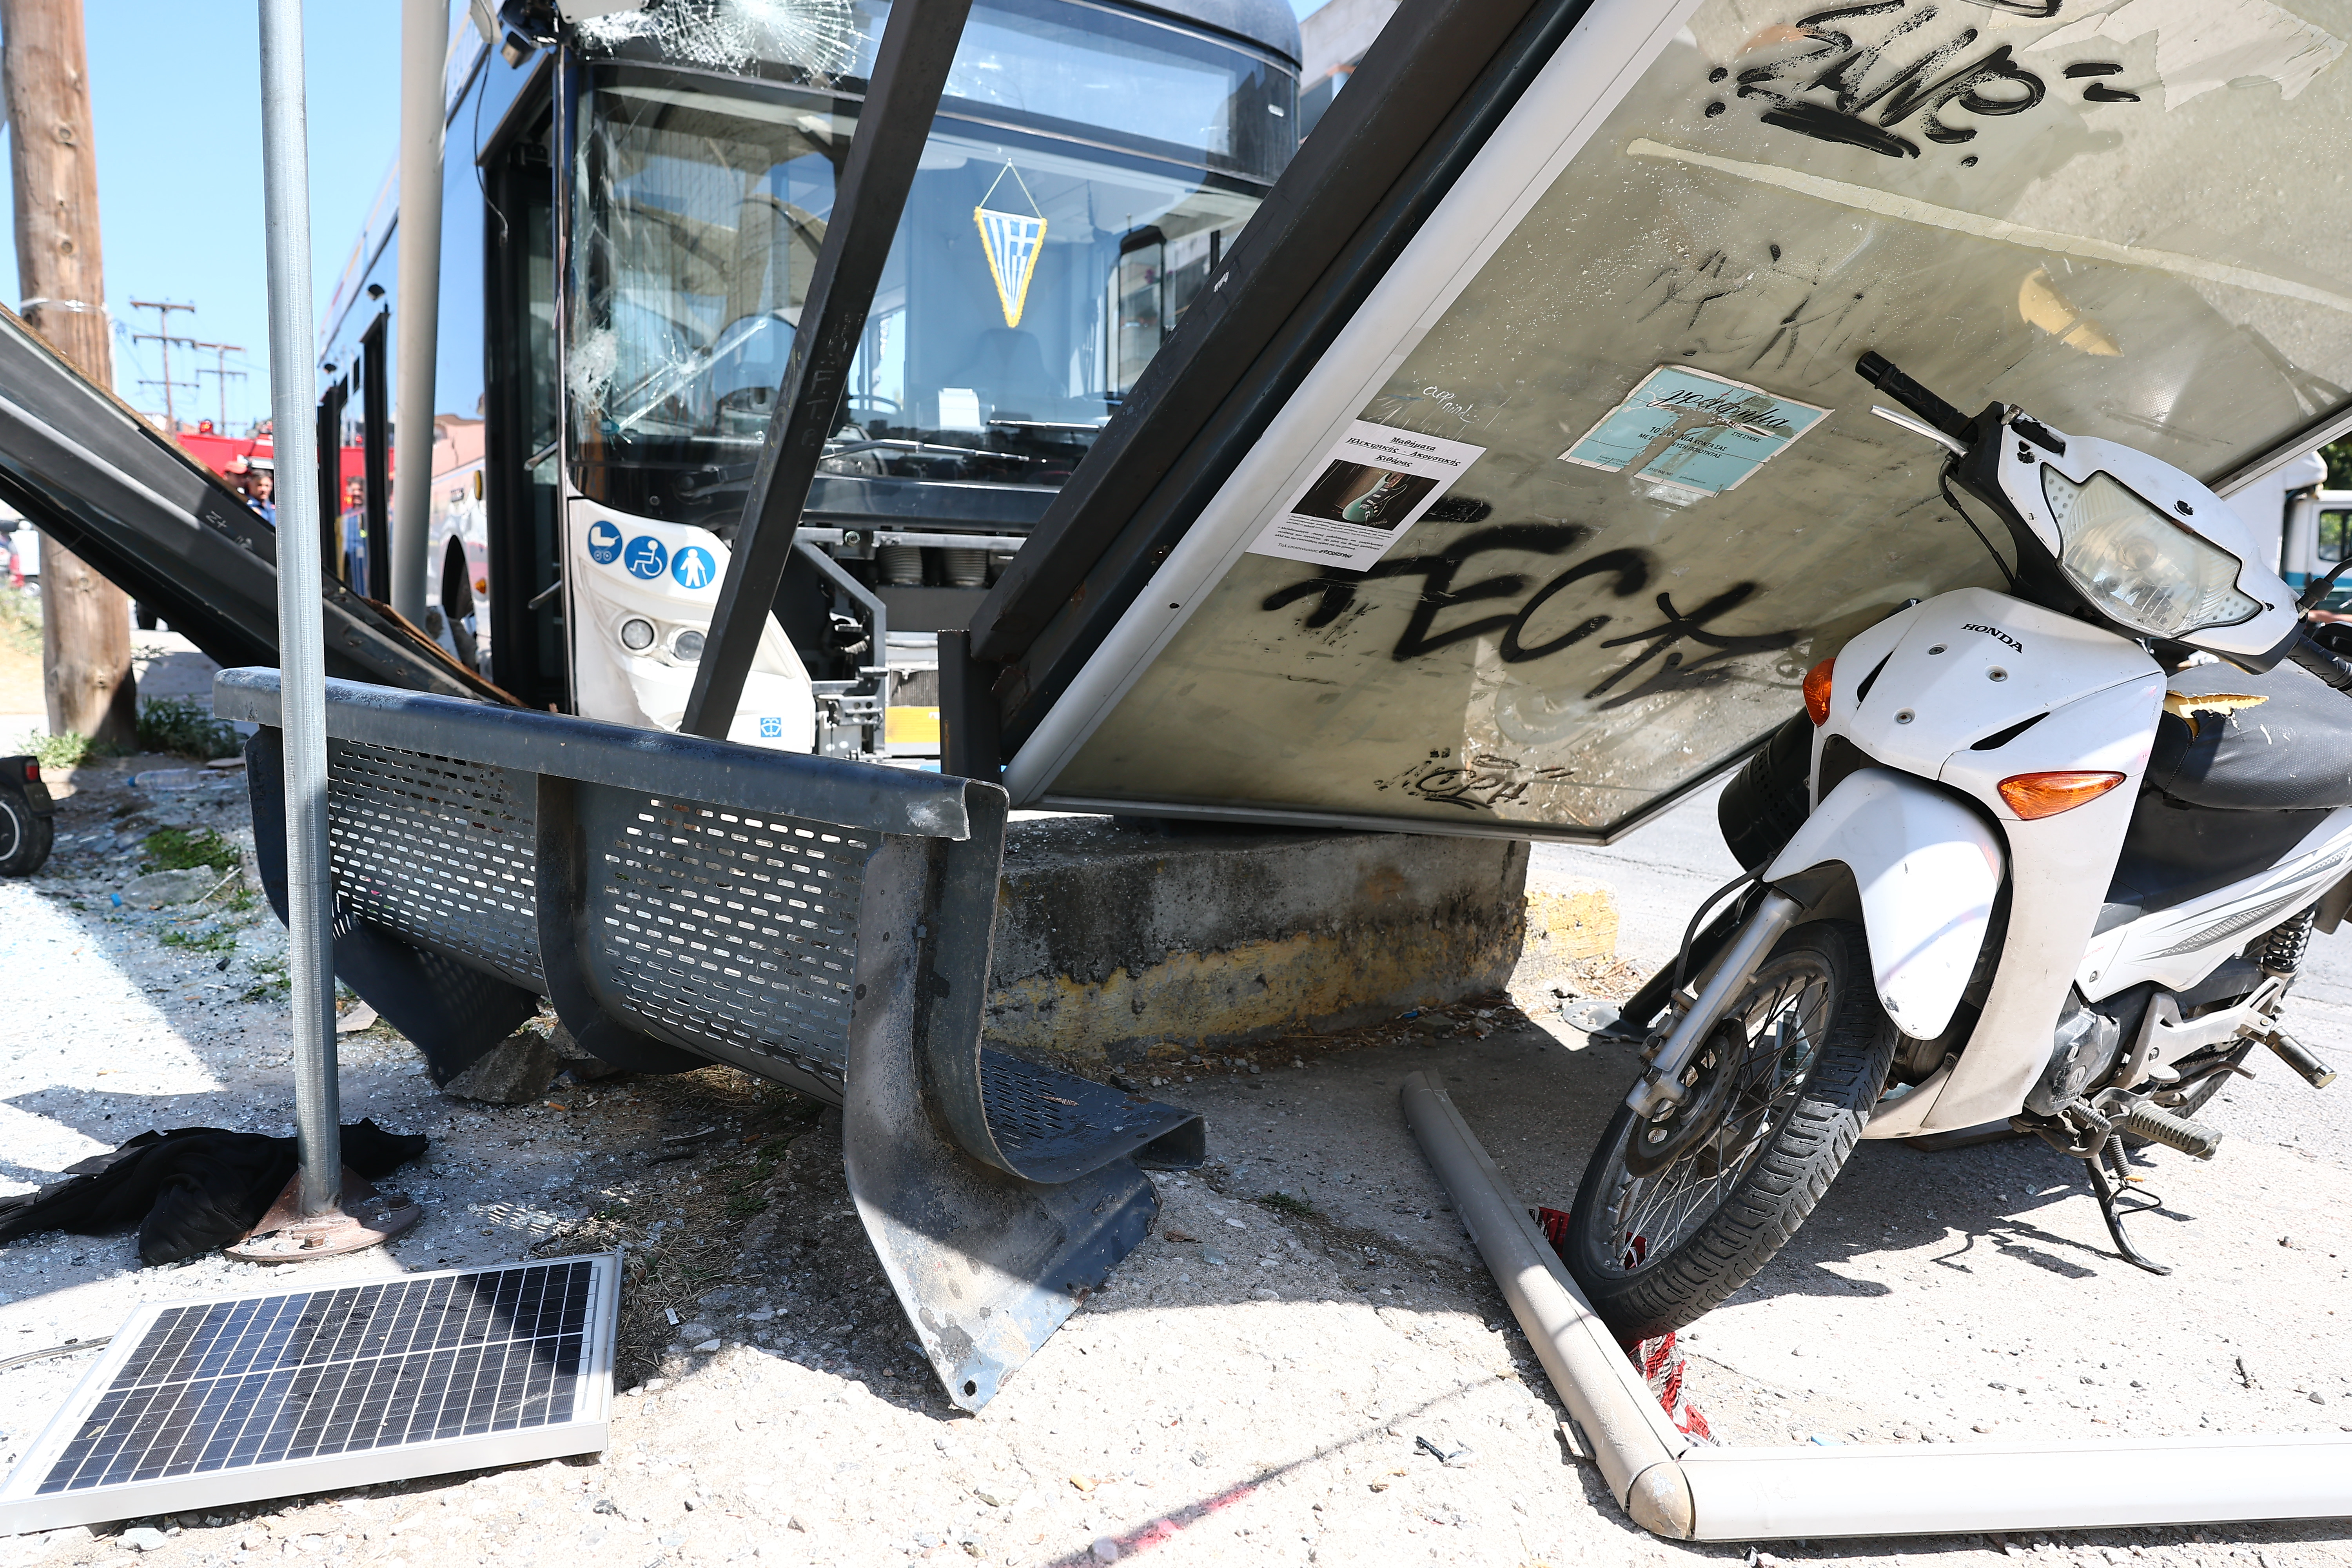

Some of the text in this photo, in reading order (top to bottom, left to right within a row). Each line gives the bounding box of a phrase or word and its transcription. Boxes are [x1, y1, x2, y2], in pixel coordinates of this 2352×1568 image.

[1389, 437, 1436, 452] Μαθήματα
[1693, 439, 1715, 448] ΚΟΝΤΑ
[1345, 437, 1399, 453] Ηλεκτρικής
[1410, 451, 1461, 467] Ακουστικής
[1688, 445, 1723, 459] ΠΟΙΟΤΗΤΑΣ
[1374, 454, 1413, 468] Κιθάρας
[1961, 623, 2023, 654] HONDA
